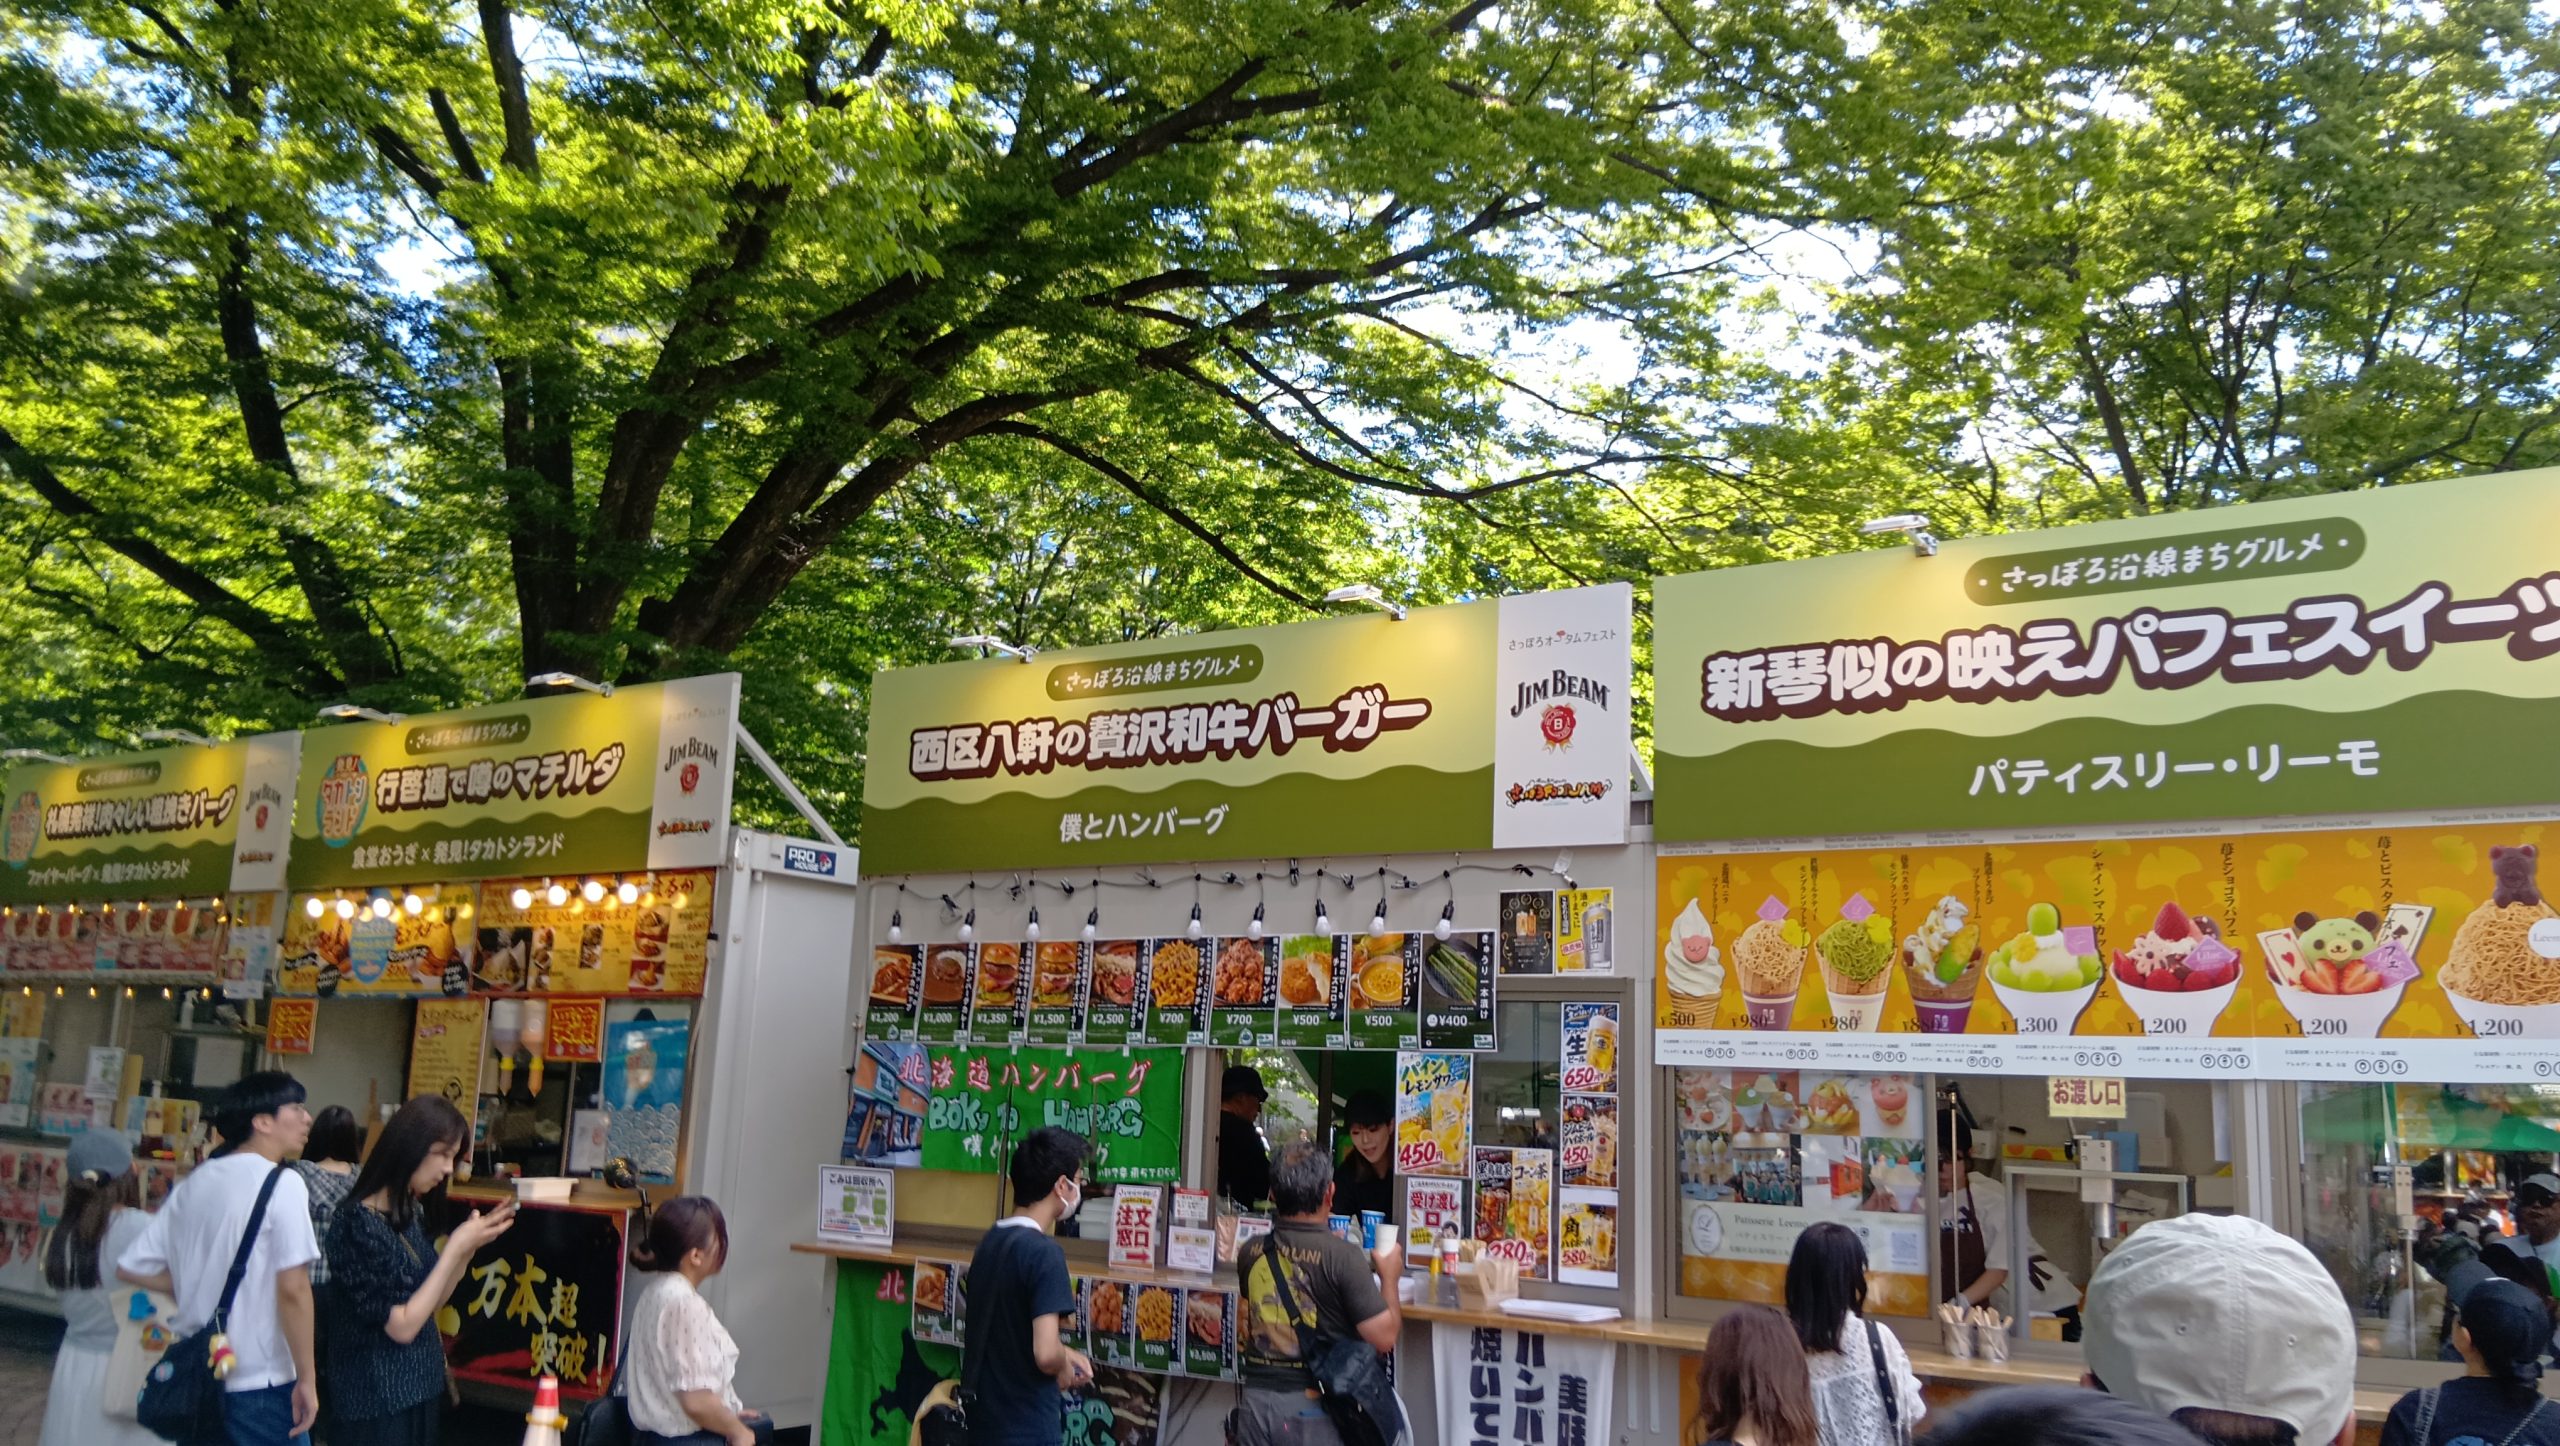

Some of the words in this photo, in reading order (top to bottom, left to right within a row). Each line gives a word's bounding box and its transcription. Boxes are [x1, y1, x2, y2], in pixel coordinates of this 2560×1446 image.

[2001, 532, 2323, 593] さっぽろ沿線まちグルメ
[1066, 655, 1242, 690] さっぽろ沿線まちグルメ
[1511, 679, 1550, 718] JIM
[1552, 669, 1610, 711] BEAM
[911, 686, 1430, 778] 西区八軒の贅沢和牛バーガー
[665, 743, 688, 771] JIM
[688, 736, 718, 768] BEAM
[376, 743, 624, 813] 行啓通で噂のマチルダ
[1969, 739, 2380, 797] パティスリー・リーモ
[1059, 805, 1229, 843] 僕とハンバーグ
[788, 847, 816, 863] PRO
[794, 861, 819, 872] HOUSE
[2221, 842, 2239, 937] 苺とショコラパフェ
[2378, 836, 2399, 968] 苺とピスタチオパフェ
[1403, 950, 1412, 1006] コーンスープ
[871, 1012, 899, 1023] ¥1,200
[924, 1012, 952, 1024] ¥1,000
[977, 1013, 1007, 1025] ¥1,350
[1034, 1014, 1065, 1025] ¥1,500
[1092, 1013, 1124, 1026] ¥2,500
[1160, 1012, 1184, 1023] ¥700
[1227, 1014, 1253, 1025] ¥700
[1293, 1014, 1320, 1025] ¥500
[1365, 1015, 1392, 1026] ¥500
[1439, 1015, 1468, 1026] ¥400
[1821, 1016, 1858, 1031] ¥980
[1566, 1034, 1588, 1057] 生
[1401, 1058, 1445, 1081] パイン
[1567, 1056, 1586, 1064] ビール
[897, 1053, 1151, 1095] 北海道ハンバーグ
[2054, 1079, 2122, 1106] お渡し口
[1400, 1140, 1443, 1166] 450円
[829, 1173, 885, 1187] ごみは回収所へ
[1514, 1162, 1548, 1180] コーン茶
[1411, 1192, 1459, 1210] 受け渡し
[1116, 1205, 1152, 1228] 注文
[1116, 1229, 1150, 1247] 窓口
[1145, 1344, 1165, 1356] ¥700
[1470, 1327, 1501, 1446] 焼いて
[1514, 1331, 1546, 1446] ハンバ
